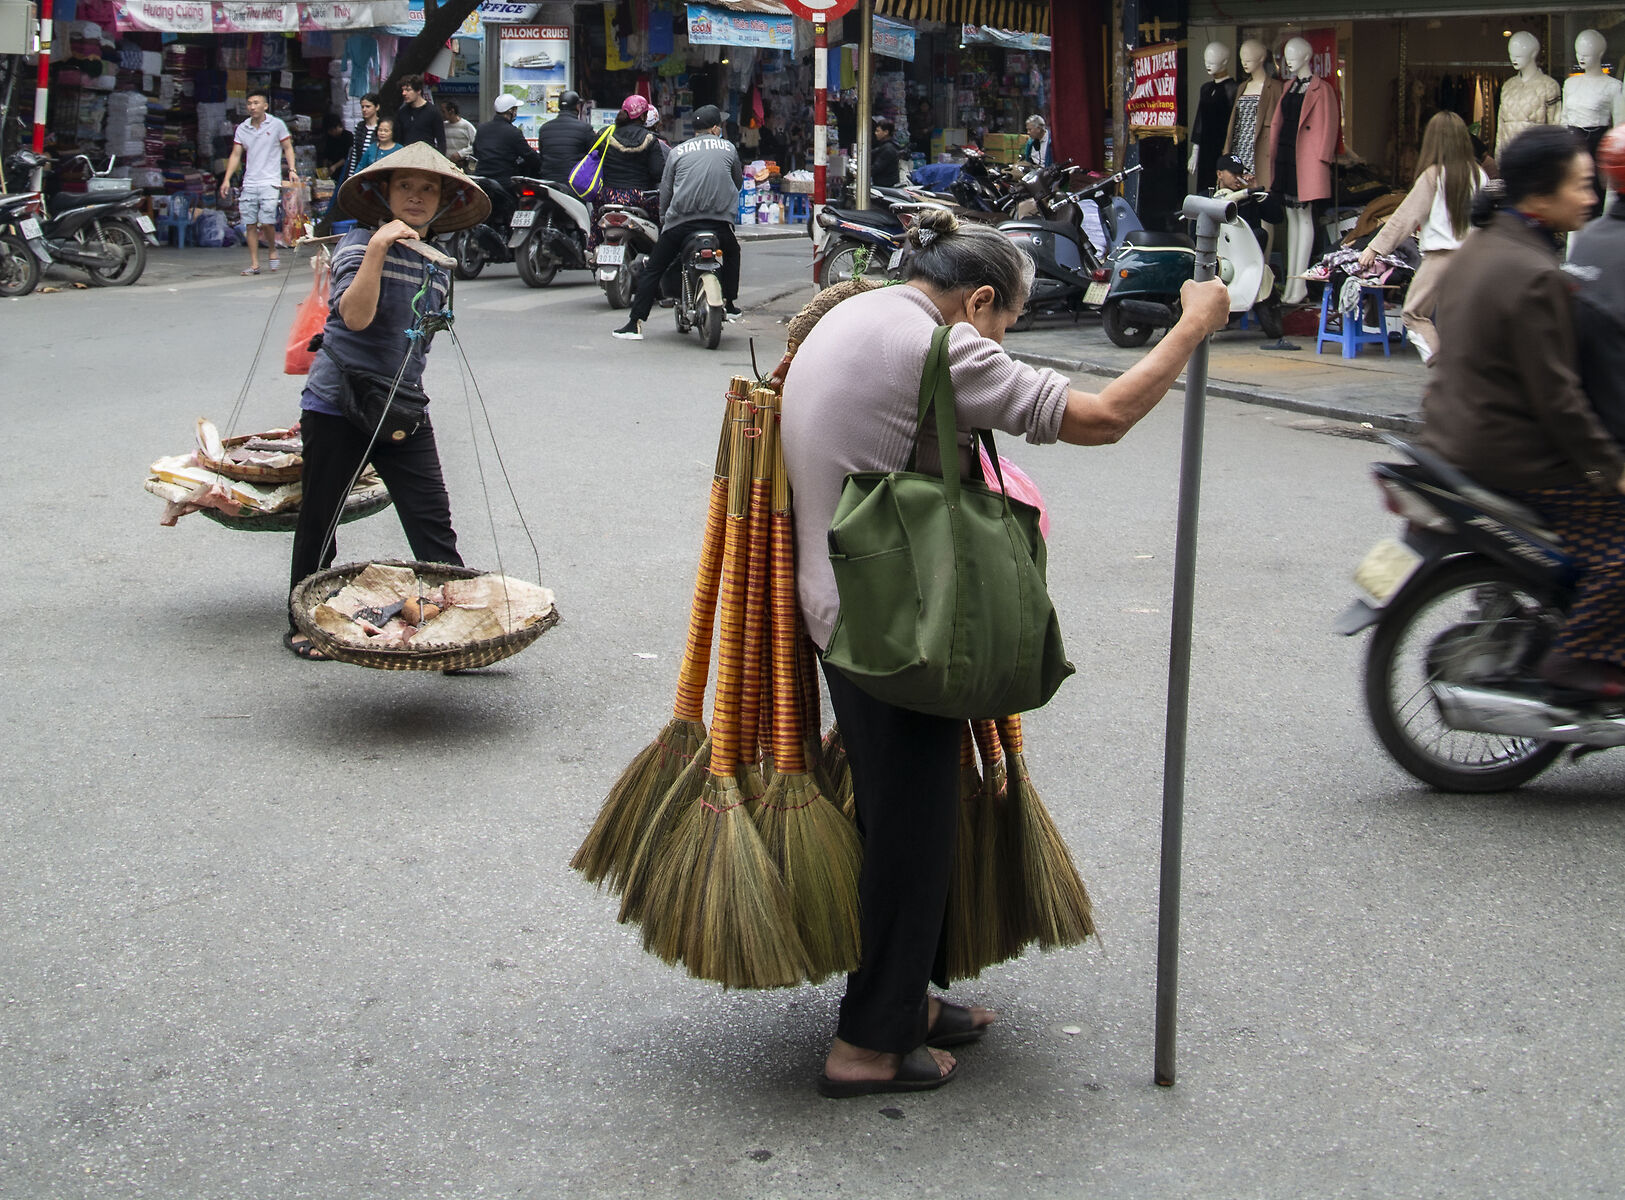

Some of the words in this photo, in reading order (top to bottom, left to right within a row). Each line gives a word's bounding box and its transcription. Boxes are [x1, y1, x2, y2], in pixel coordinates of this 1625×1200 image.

[501, 27, 540, 39] HALONG
[541, 27, 569, 39] CRUISE
[1154, 73, 1176, 96] VIÊN
[677, 140, 702, 155] STAY
[702, 138, 731, 152] TRUE
